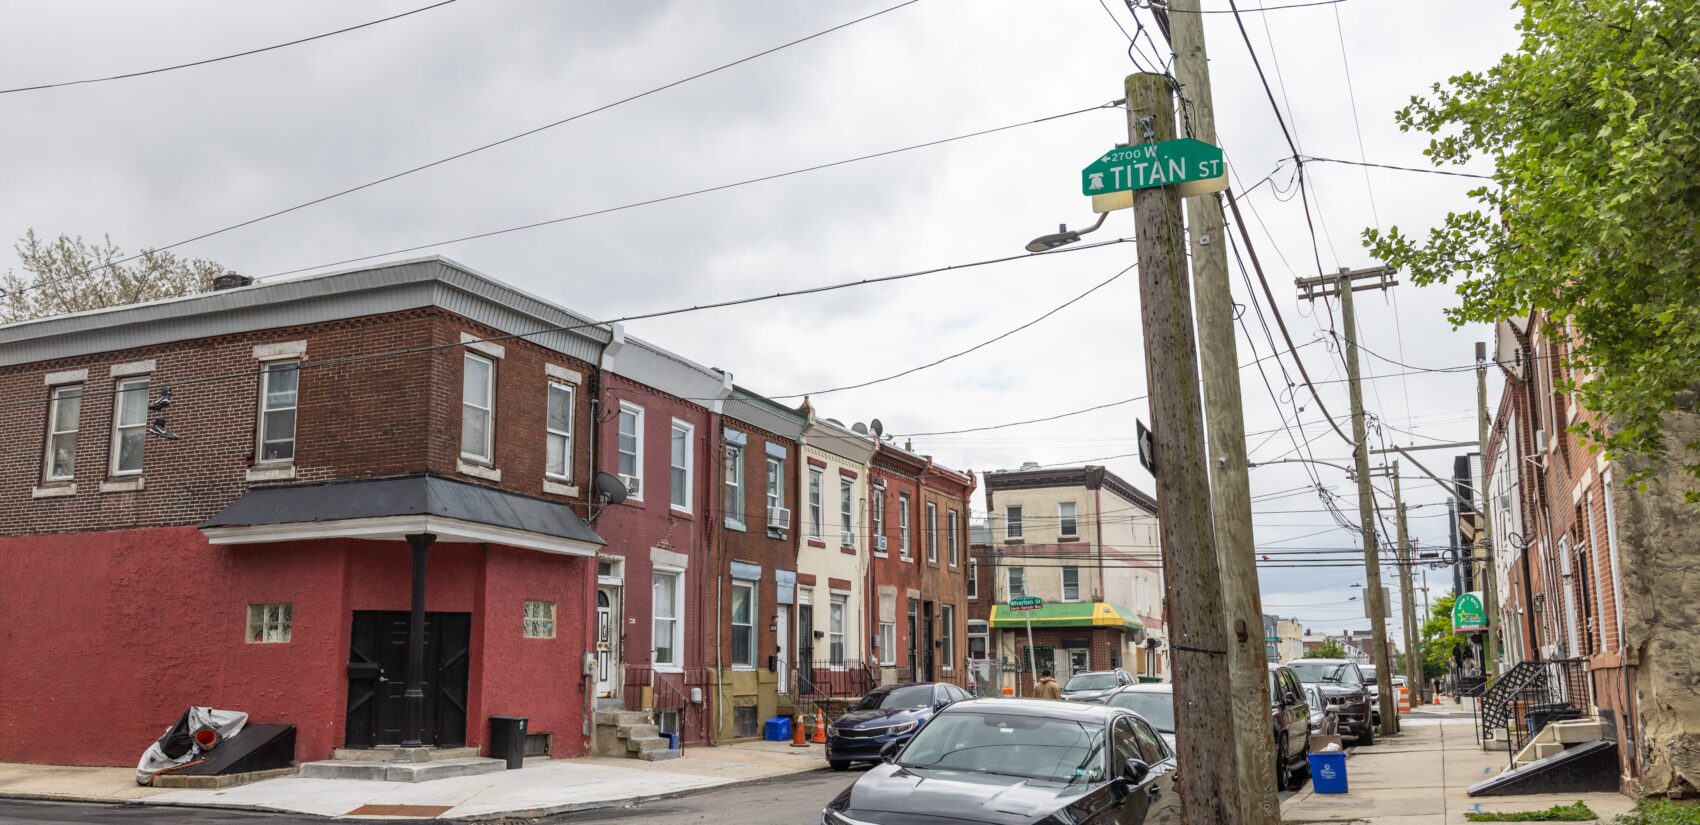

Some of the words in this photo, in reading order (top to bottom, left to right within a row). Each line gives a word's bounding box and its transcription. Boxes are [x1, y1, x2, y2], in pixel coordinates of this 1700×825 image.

[1111, 149, 1141, 162] 2700
[1144, 145, 1158, 158] W
[1110, 157, 1186, 189] TITAN
[1198, 159, 1220, 177] ST
